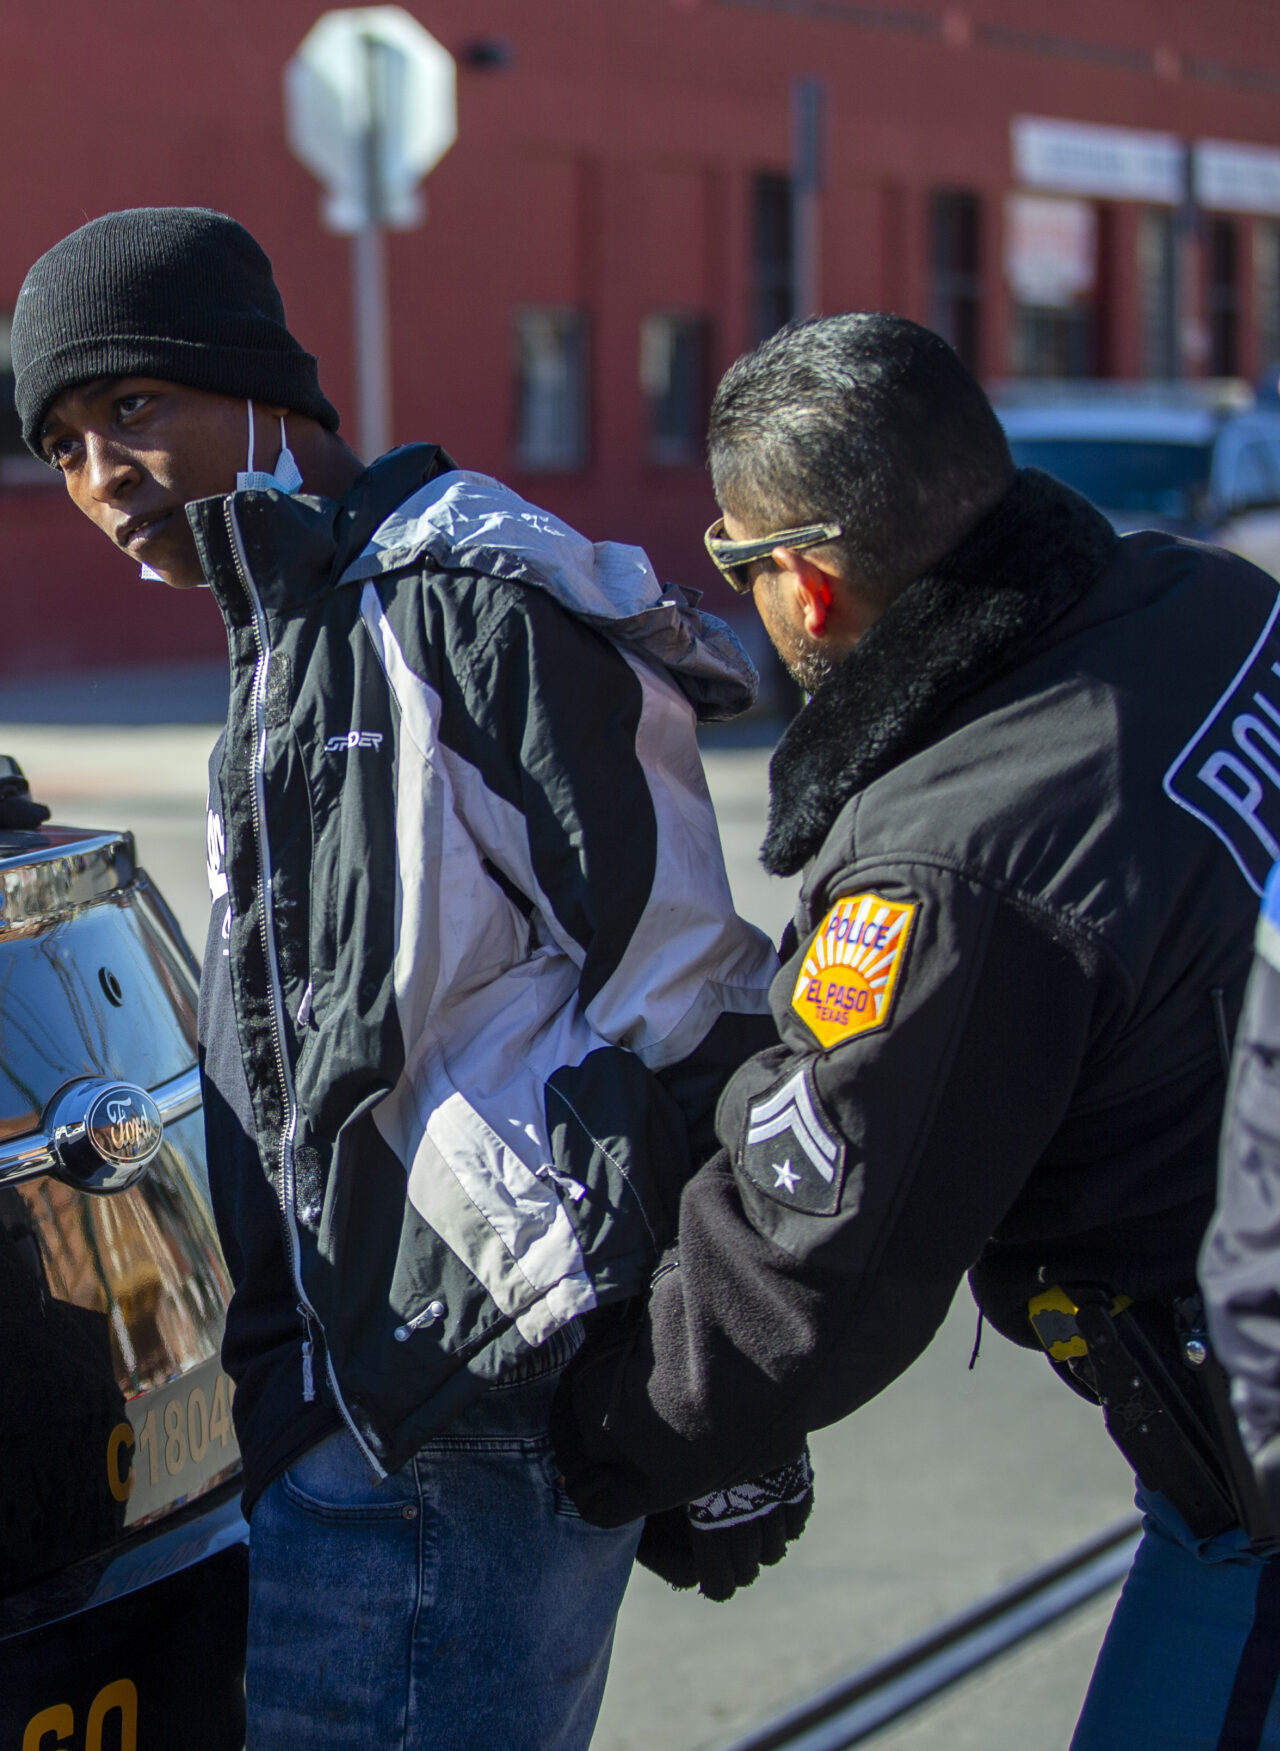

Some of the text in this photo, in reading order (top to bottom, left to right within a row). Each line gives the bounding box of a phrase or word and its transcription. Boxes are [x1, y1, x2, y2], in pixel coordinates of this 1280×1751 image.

[825, 916, 890, 950] POLICE
[806, 978, 869, 1013] EL PASO
[816, 1004, 850, 1026] TEXAS
[106, 1096, 153, 1150] Ford
